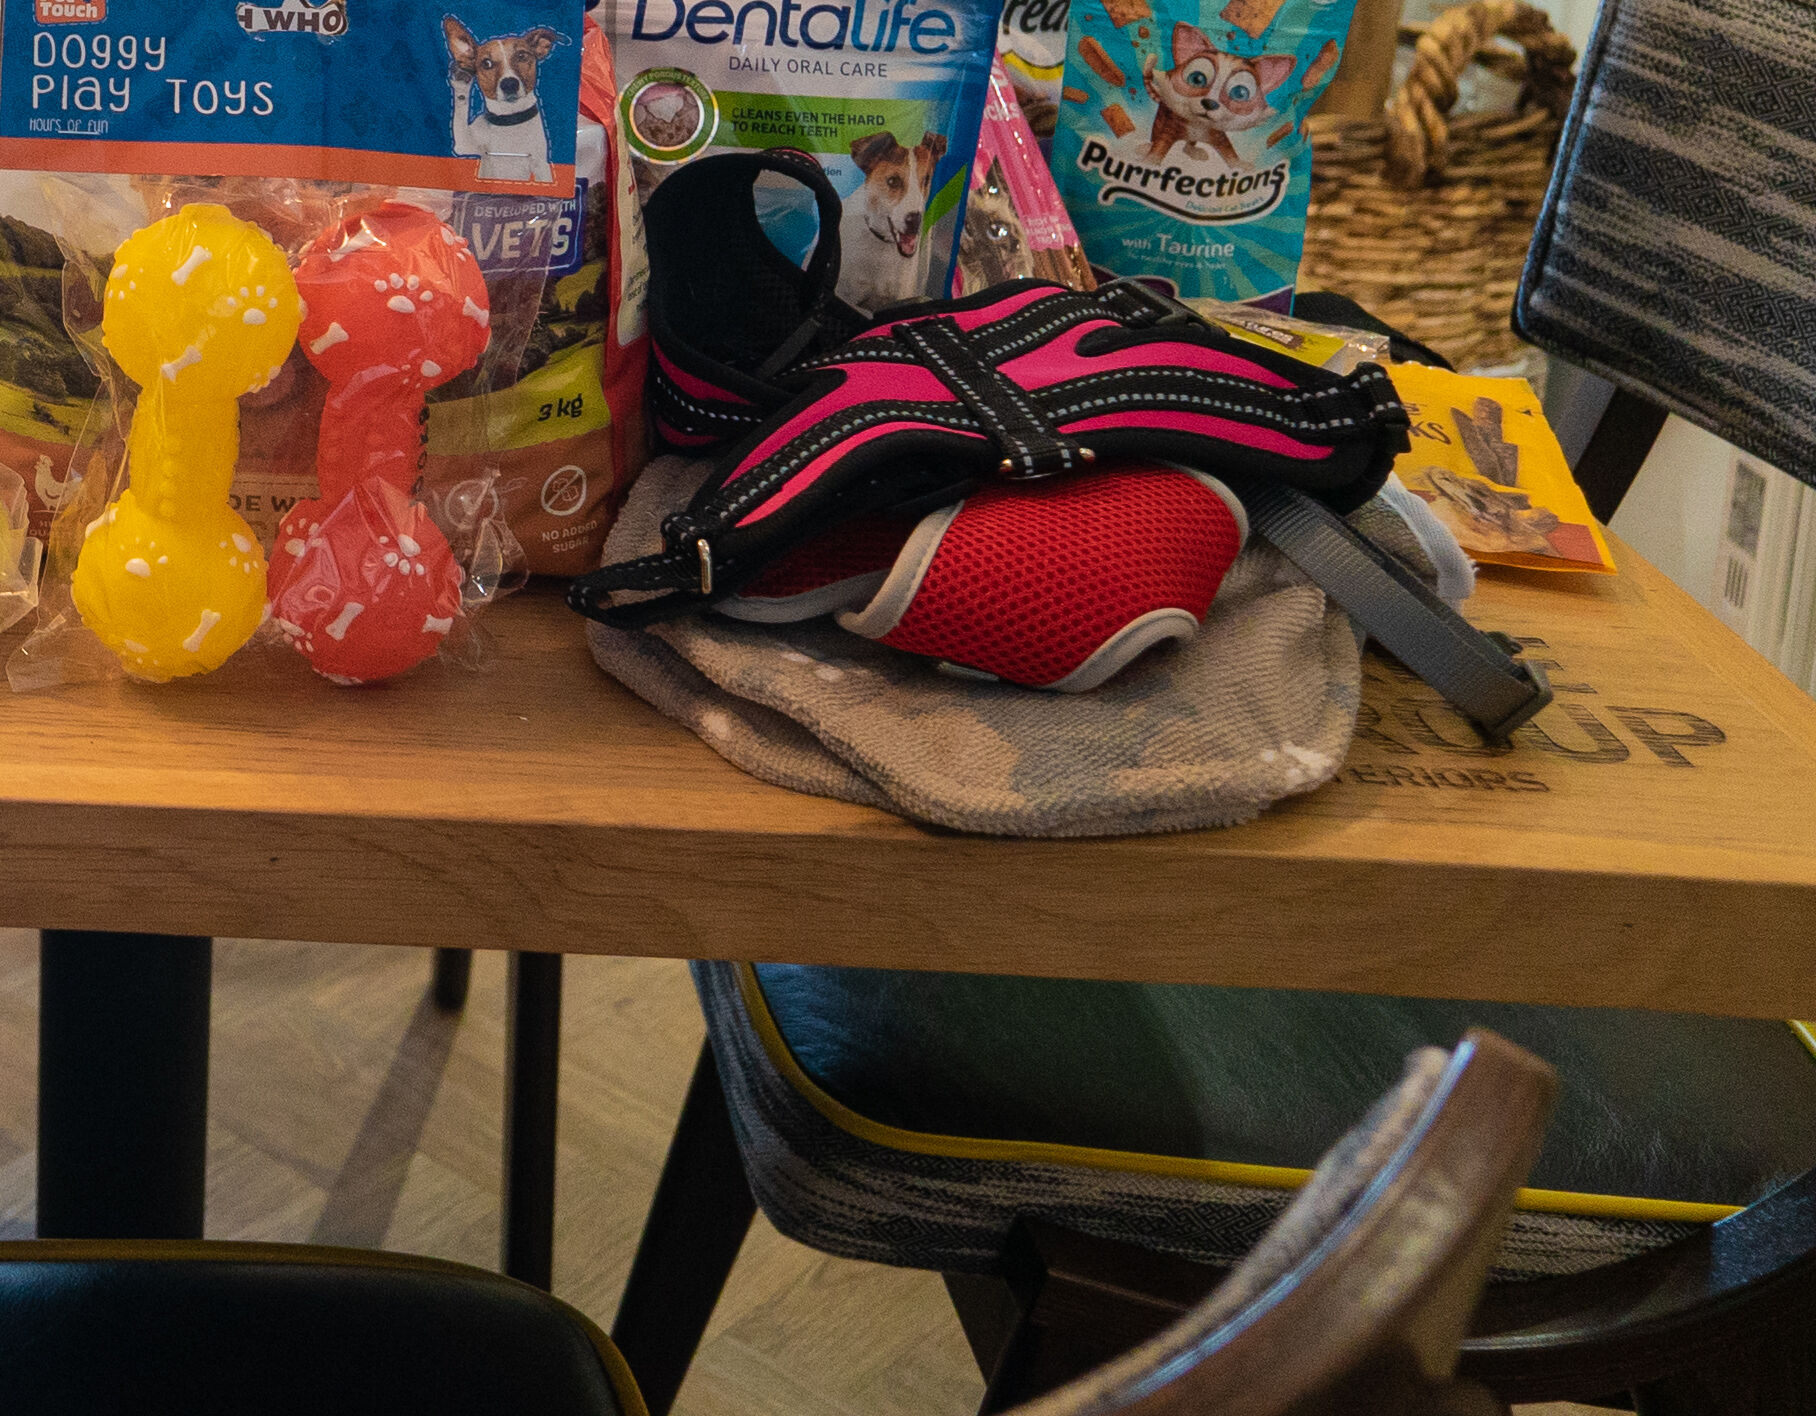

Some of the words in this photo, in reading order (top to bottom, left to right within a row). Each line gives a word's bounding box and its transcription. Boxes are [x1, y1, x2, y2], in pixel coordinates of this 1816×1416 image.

[40, 3, 98, 19] Touch
[728, 56, 780, 73] DAILY
[787, 58, 834, 75] ORAL
[839, 61, 888, 78] CARE
[731, 107, 783, 121] CLEANS
[785, 110, 825, 123] EVEN
[826, 112, 846, 124] THE
[847, 113, 885, 126] HARD
[732, 119, 749, 132] TO
[751, 122, 796, 134] REACH
[799, 124, 838, 137] TEETH
[1081, 140, 1286, 198] Purrfections
[473, 202, 547, 218] DEVELOPED
[471, 217, 573, 261] VETS
[1121, 235, 1152, 250] with
[1157, 233, 1235, 259] Taurine
[537, 403, 553, 422] 3
[556, 393, 583, 419] kg
[541, 530, 561, 542] NO
[552, 539, 590, 554] SUGAR
[1336, 764, 1551, 793] TERIORS
